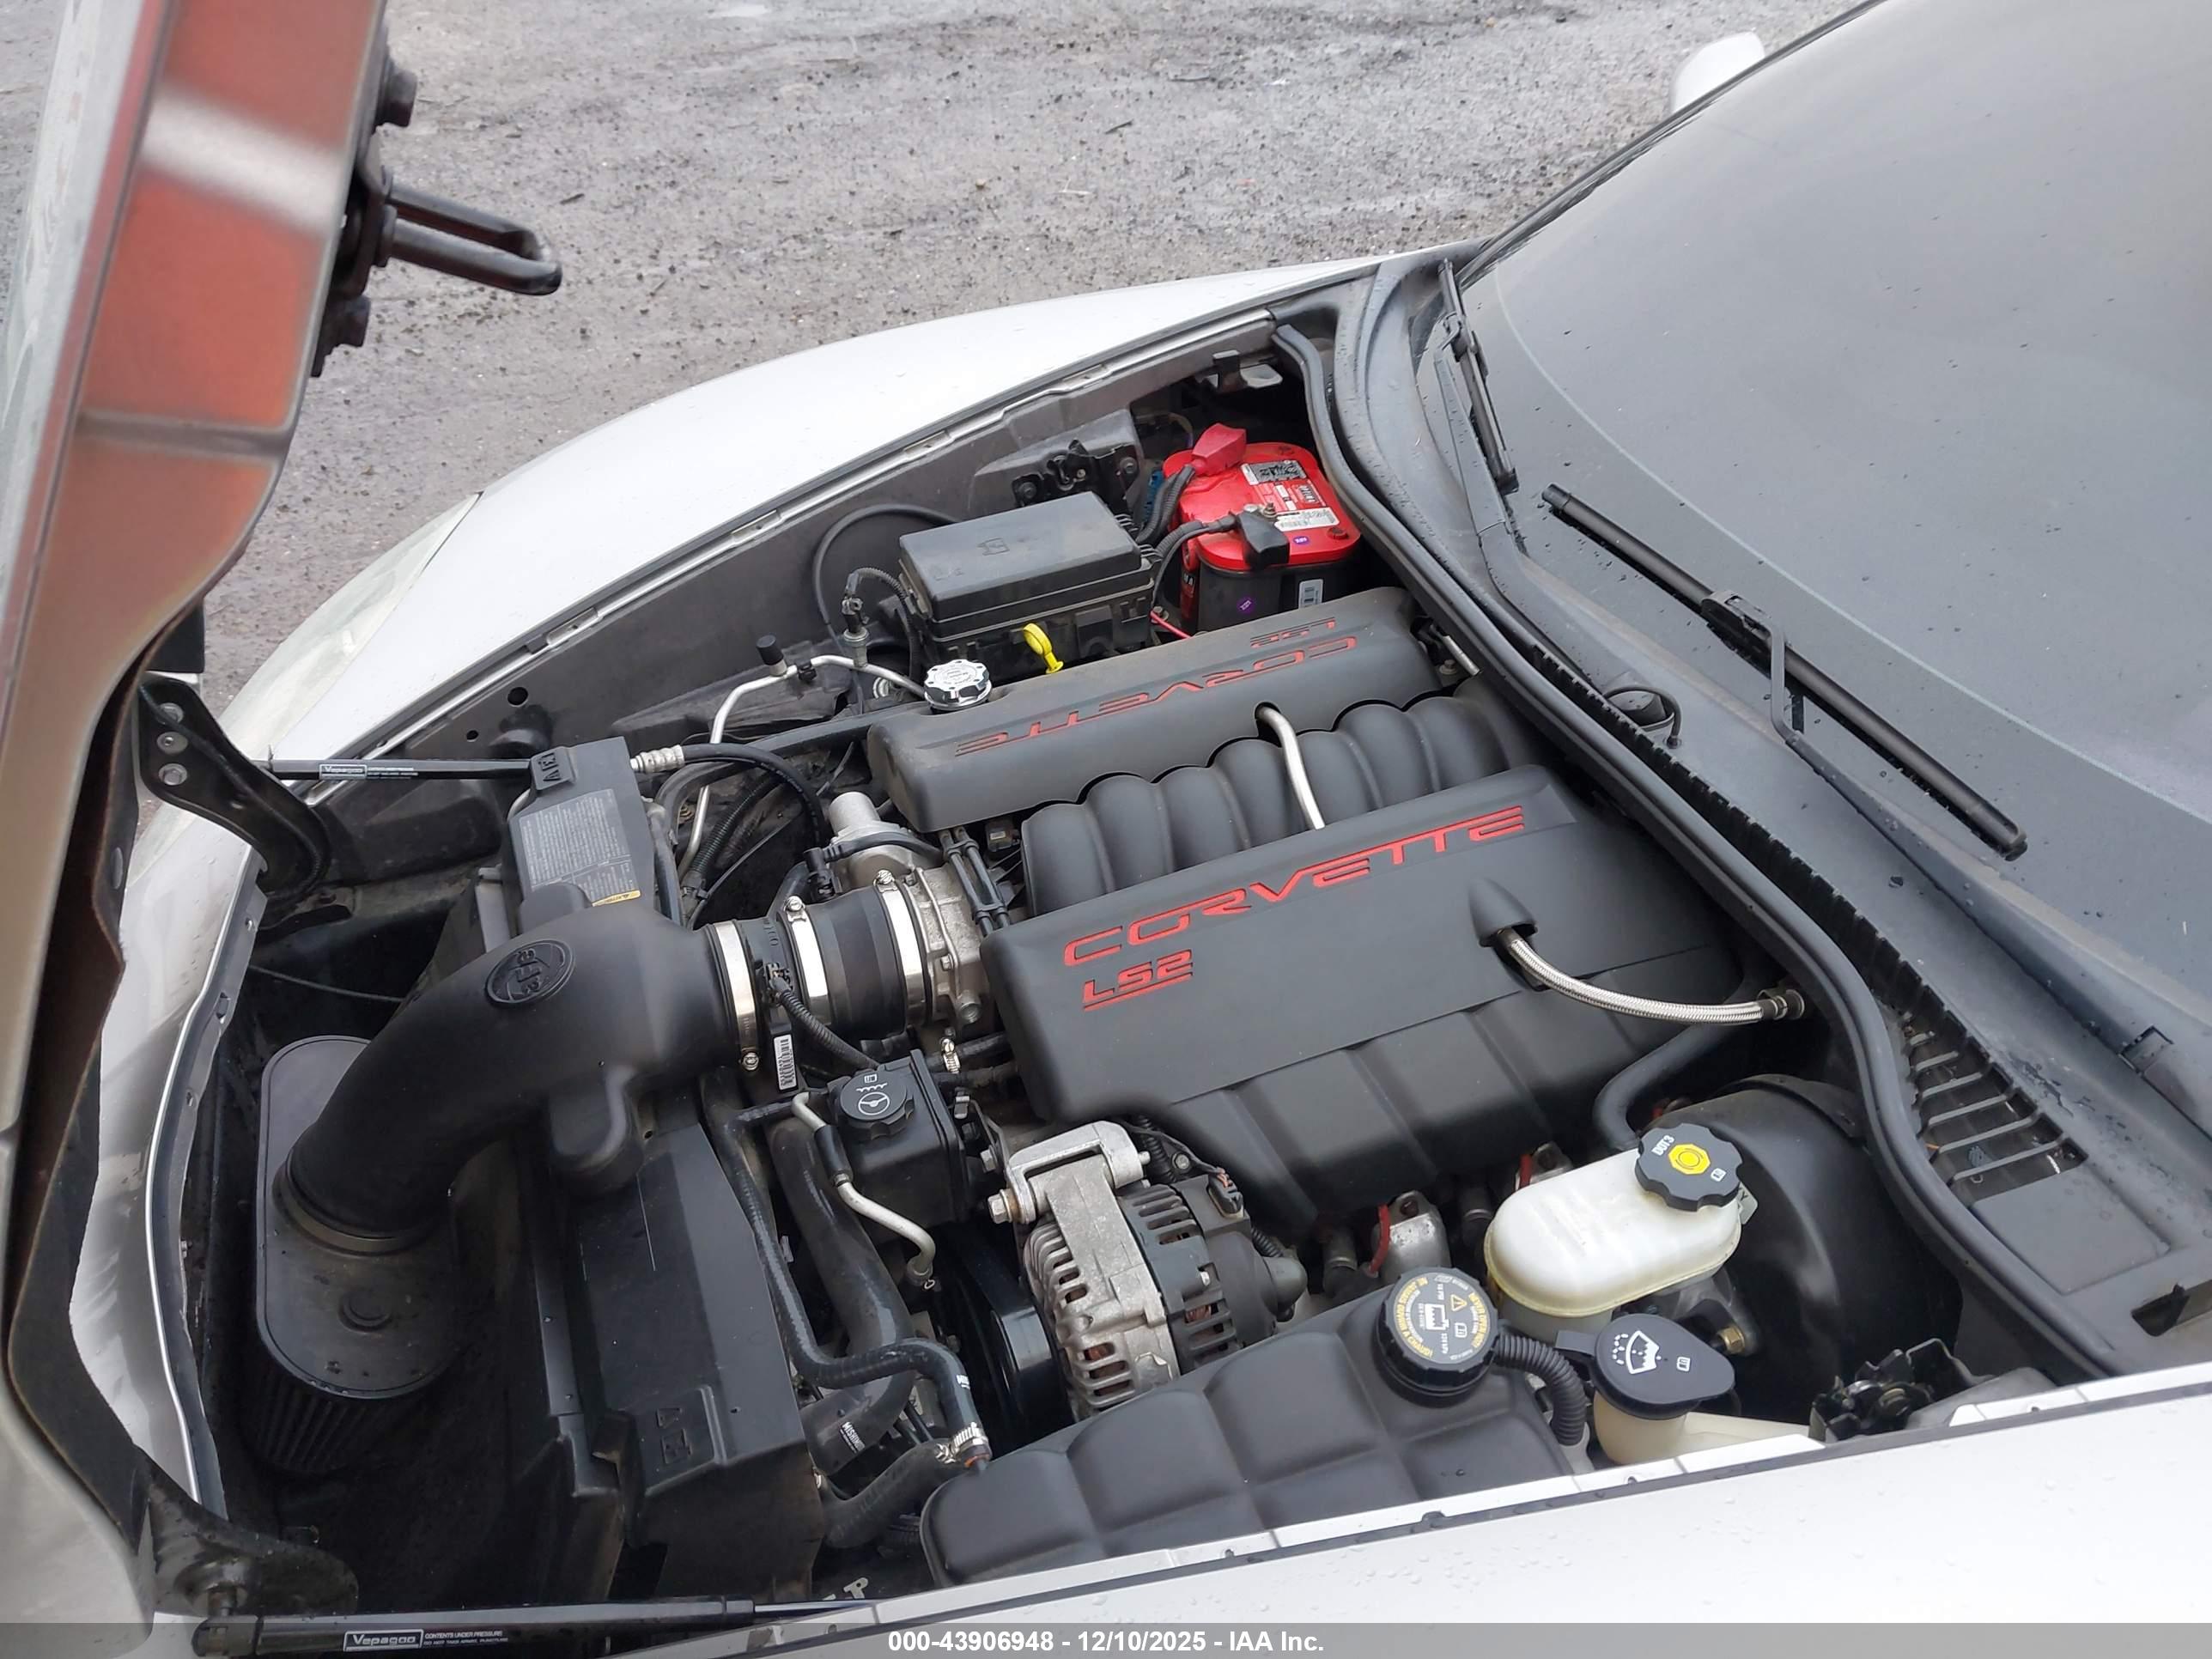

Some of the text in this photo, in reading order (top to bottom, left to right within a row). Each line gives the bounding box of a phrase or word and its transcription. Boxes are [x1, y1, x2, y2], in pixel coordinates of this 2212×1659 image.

[1250, 617, 1337, 648] LS2
[955, 636, 1357, 757] CORVETTE
[1063, 805, 1525, 967] CORVETTE
[1083, 948, 1194, 1006] LS2
[352, 1633, 416, 1647] Vepagoo
